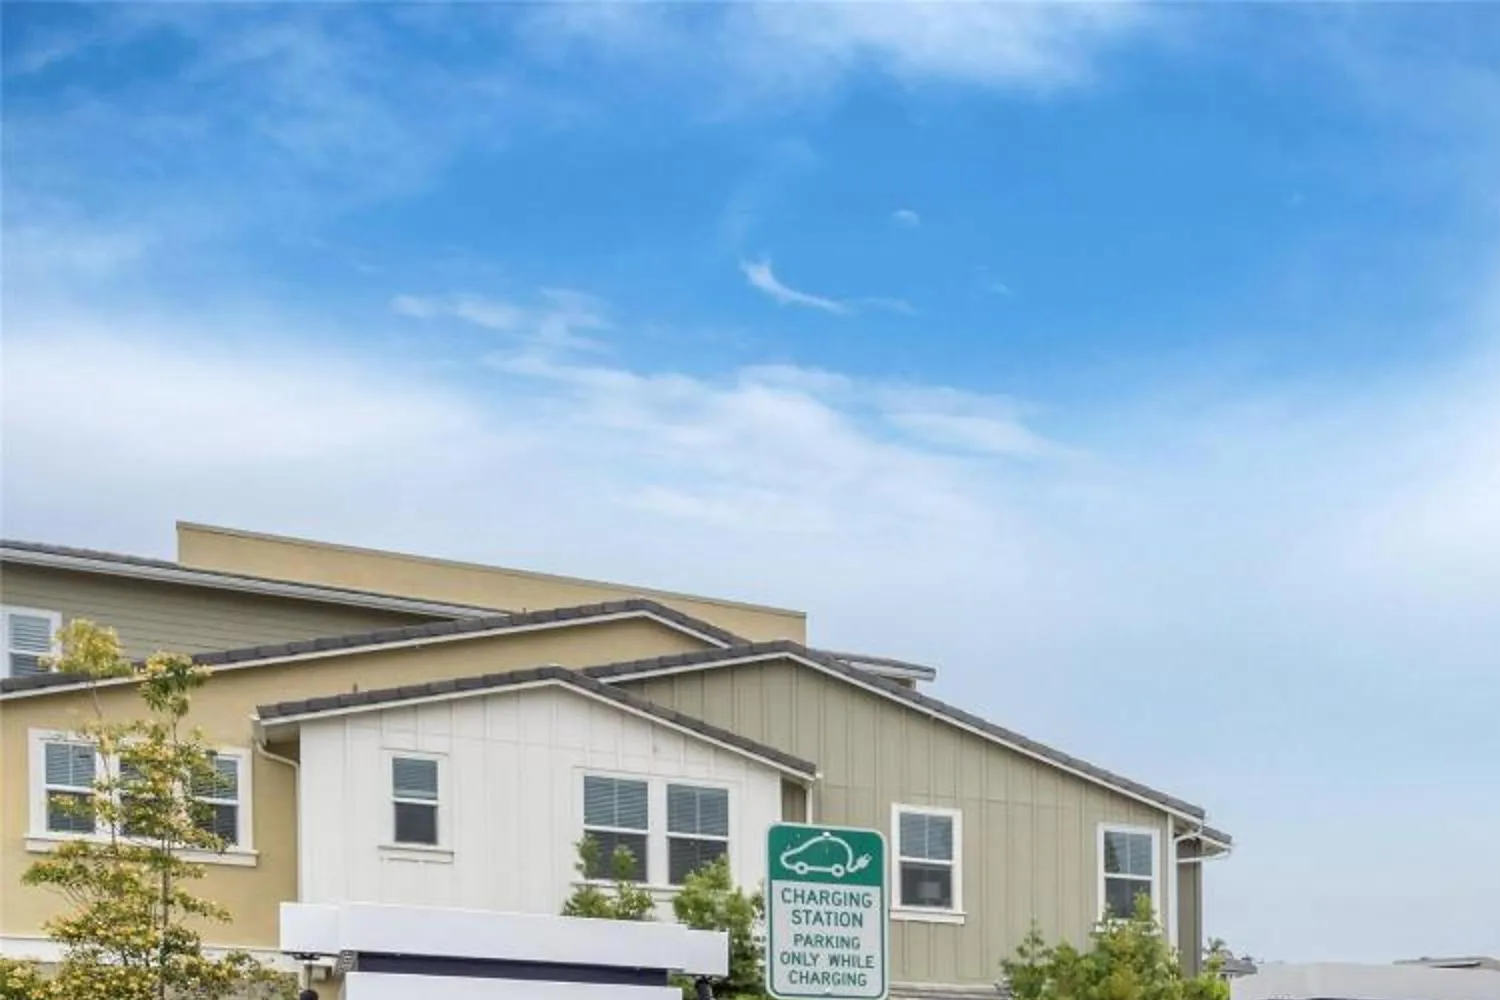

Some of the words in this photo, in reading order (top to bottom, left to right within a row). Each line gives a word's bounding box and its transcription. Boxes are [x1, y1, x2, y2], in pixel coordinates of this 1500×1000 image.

[781, 887, 873, 908] CHARGING
[791, 910, 863, 928] STATION
[793, 933, 861, 949] PARKING
[780, 951, 820, 967] ONLY
[828, 954, 875, 969] WHILE
[788, 970, 868, 986] CHARGING
